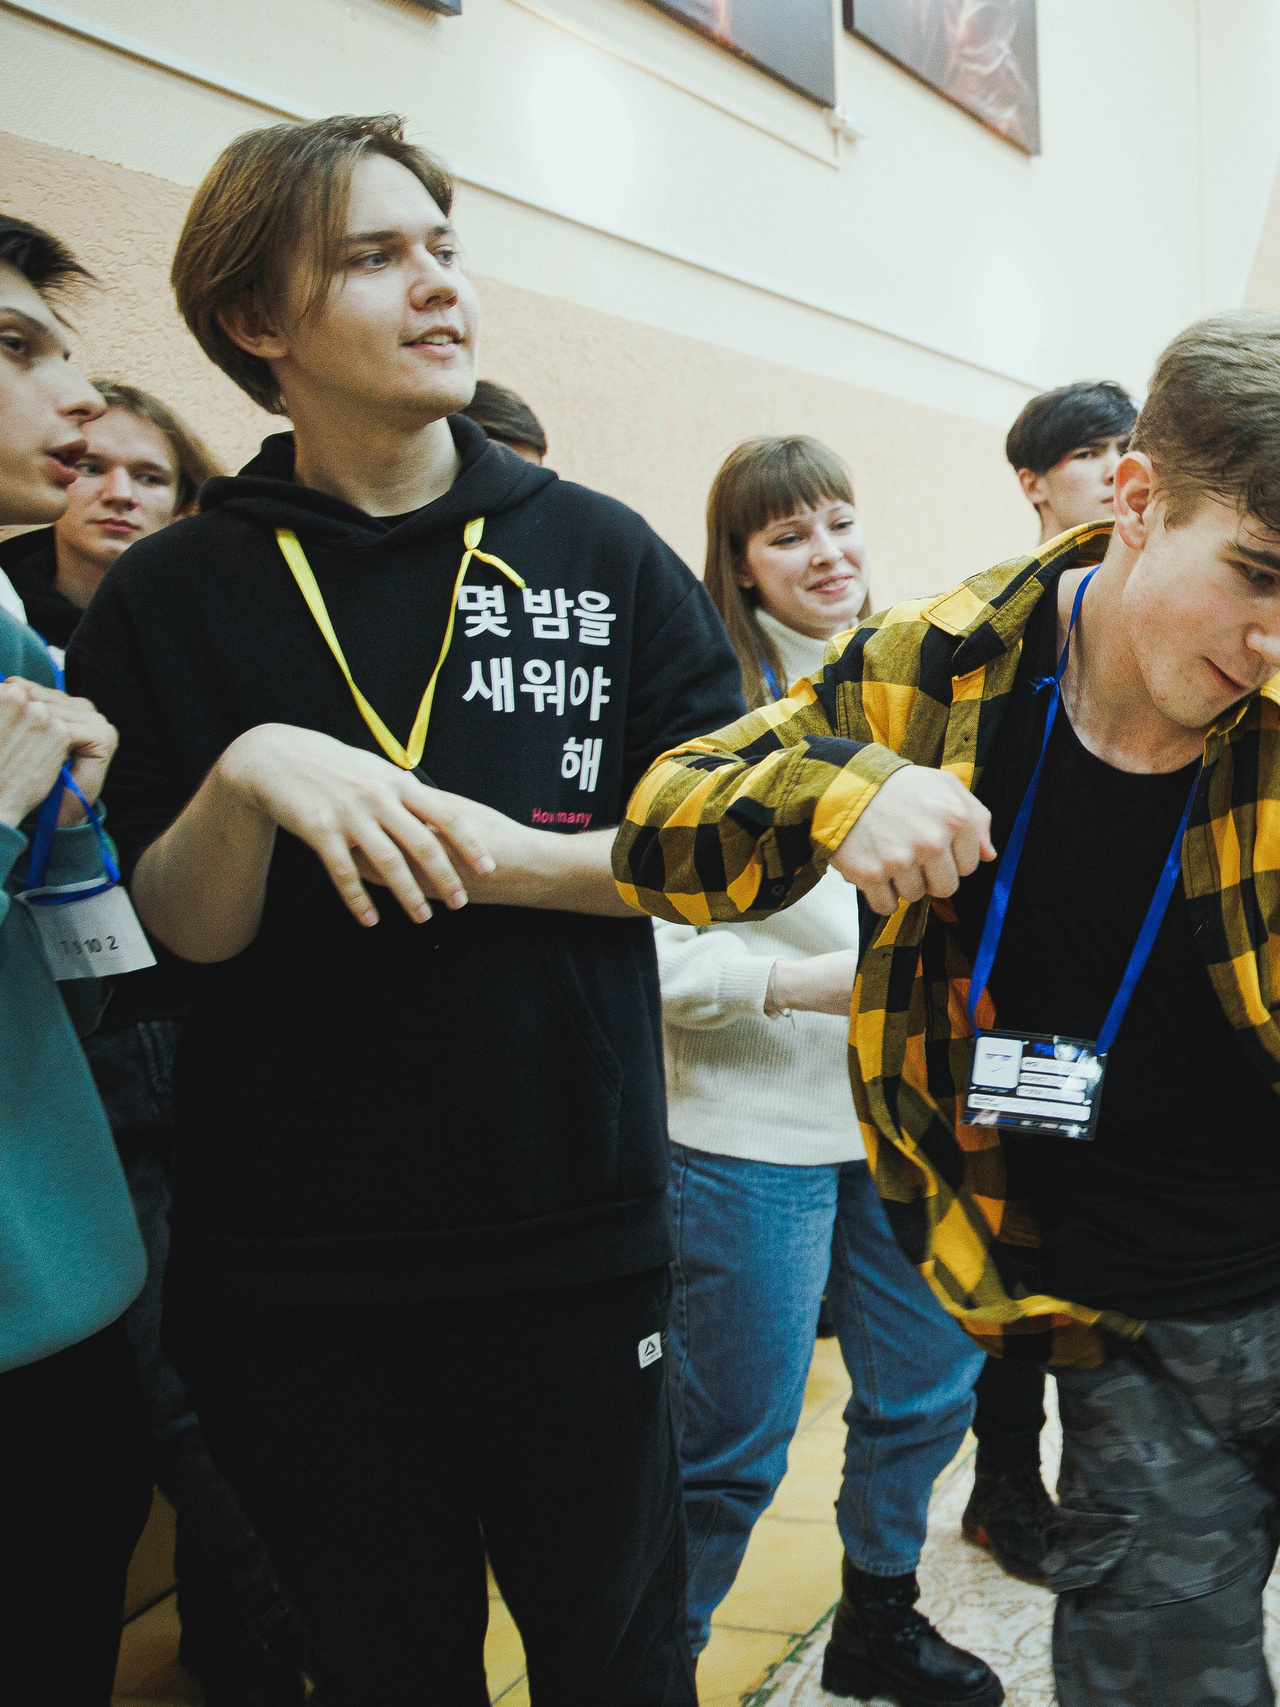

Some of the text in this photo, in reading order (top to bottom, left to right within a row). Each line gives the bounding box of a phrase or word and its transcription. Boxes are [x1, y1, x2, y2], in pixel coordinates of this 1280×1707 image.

[458, 585, 616, 646] 몇 밤을
[462, 657, 611, 721] 새워야
[561, 736, 603, 792] 해
